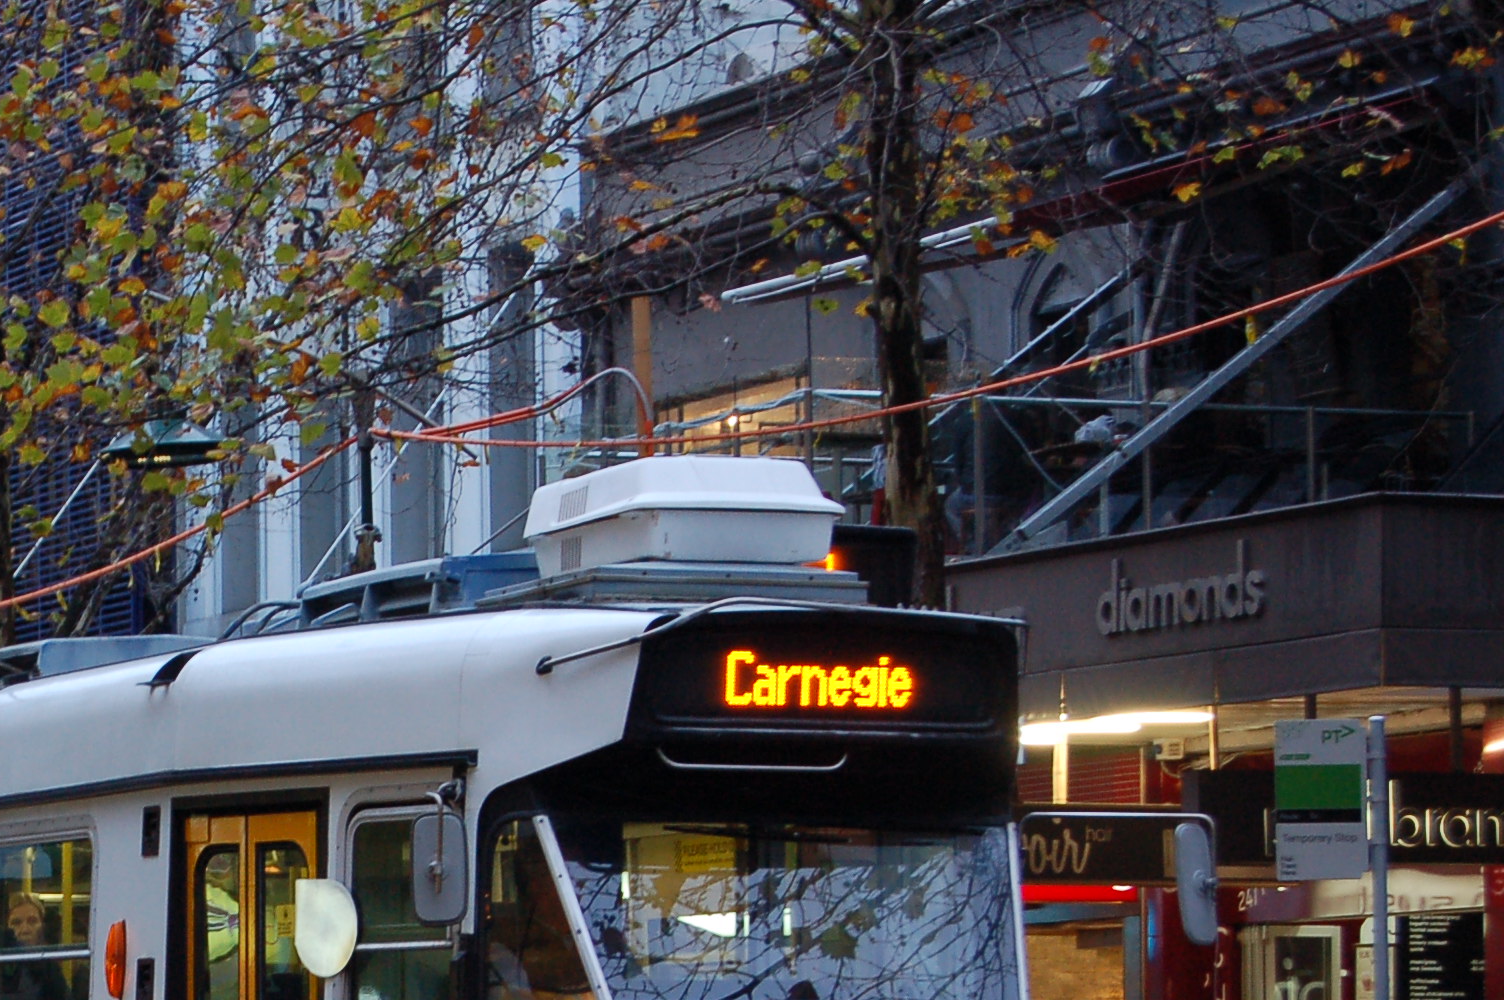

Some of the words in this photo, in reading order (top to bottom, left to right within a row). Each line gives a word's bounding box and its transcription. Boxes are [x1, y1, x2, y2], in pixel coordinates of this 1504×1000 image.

[1097, 539, 1264, 636] diamonds
[725, 650, 913, 708] Carnegie
[1283, 832, 1332, 845] Temporary
[1335, 832, 1358, 844] Stop
